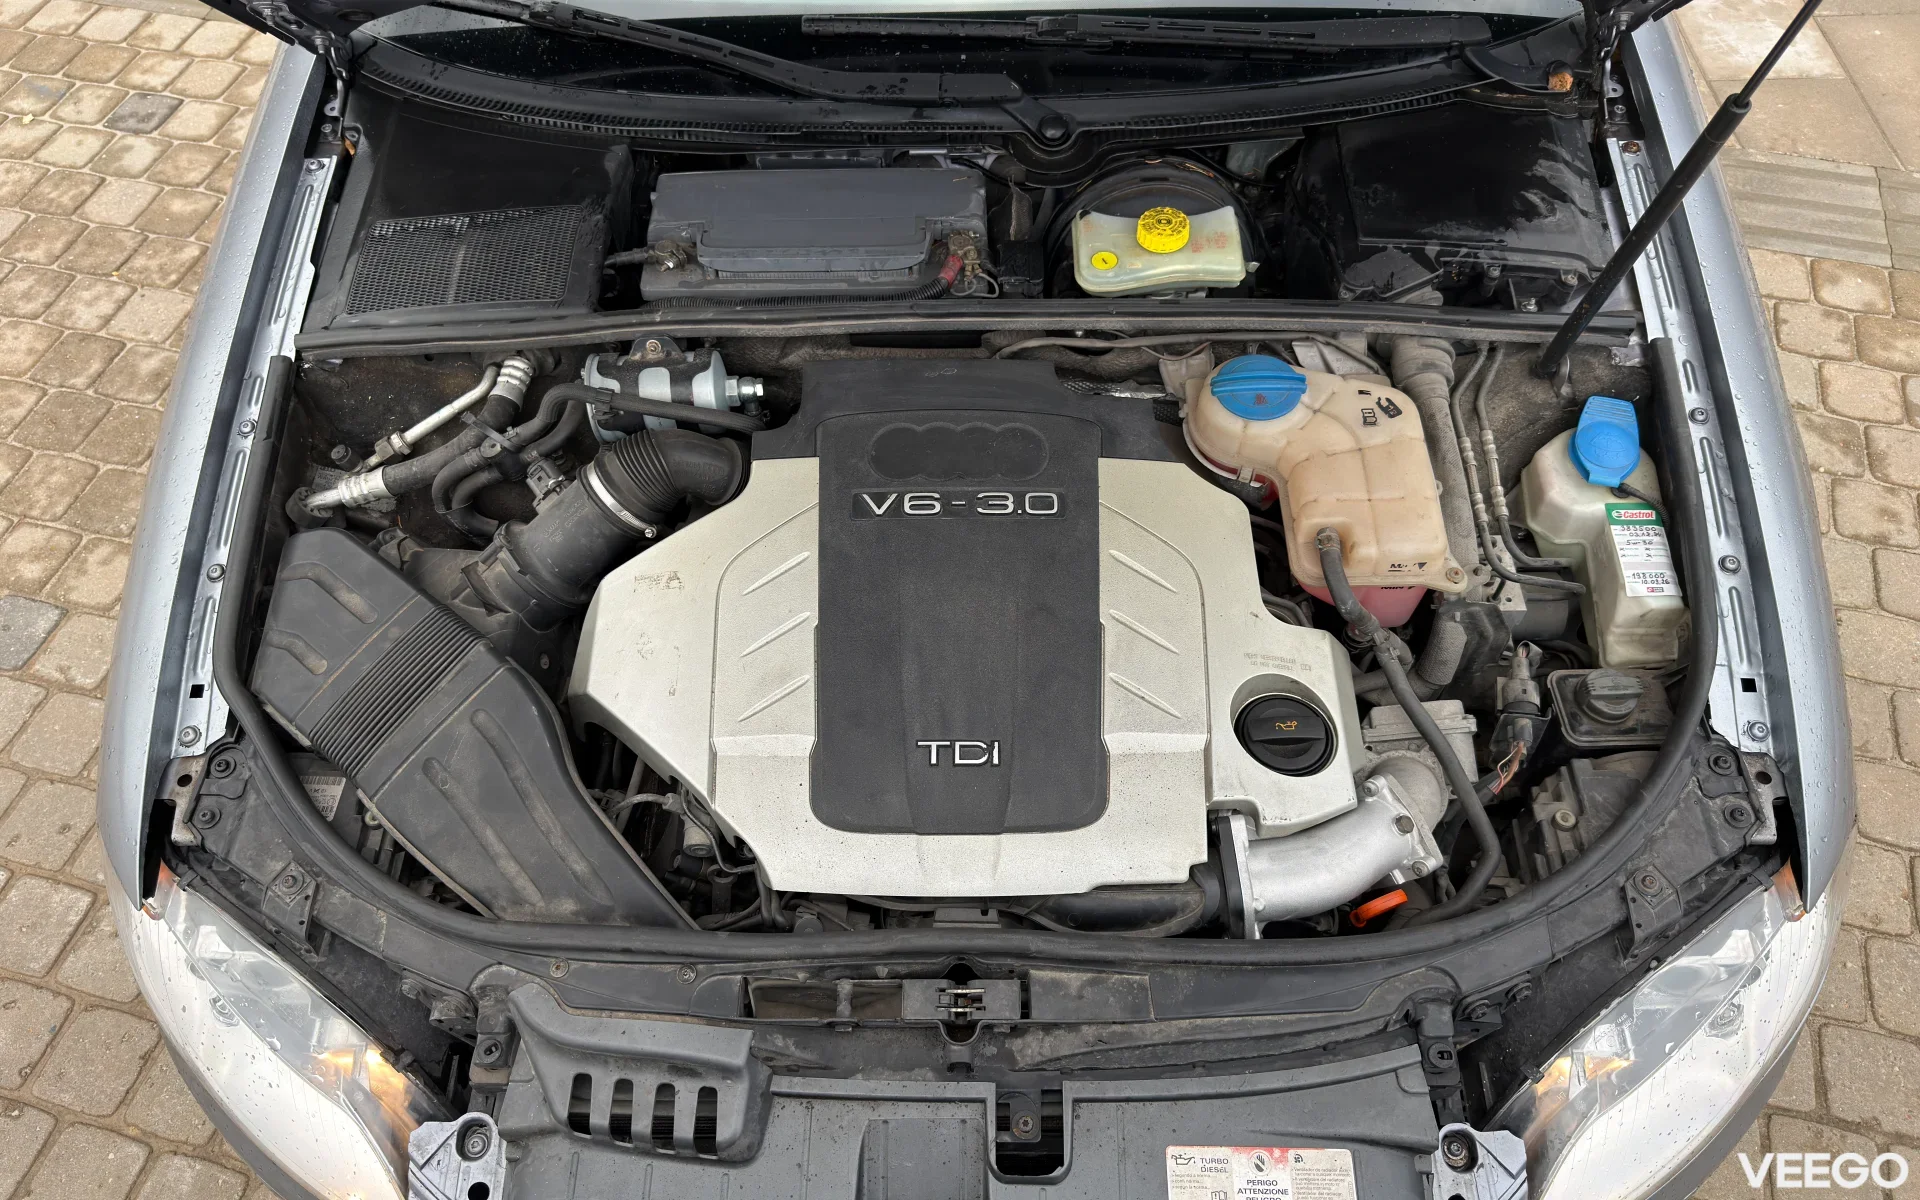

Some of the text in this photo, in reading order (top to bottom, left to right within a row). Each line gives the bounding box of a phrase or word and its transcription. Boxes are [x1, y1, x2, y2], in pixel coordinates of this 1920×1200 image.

[860, 492, 942, 515] V6
[976, 492, 1059, 515] 3.0
[1623, 511, 1655, 519] Castrol
[917, 741, 999, 765] TDI
[1200, 1157, 1229, 1165] TURBO
[1246, 1179, 1278, 1187] PERIGO
